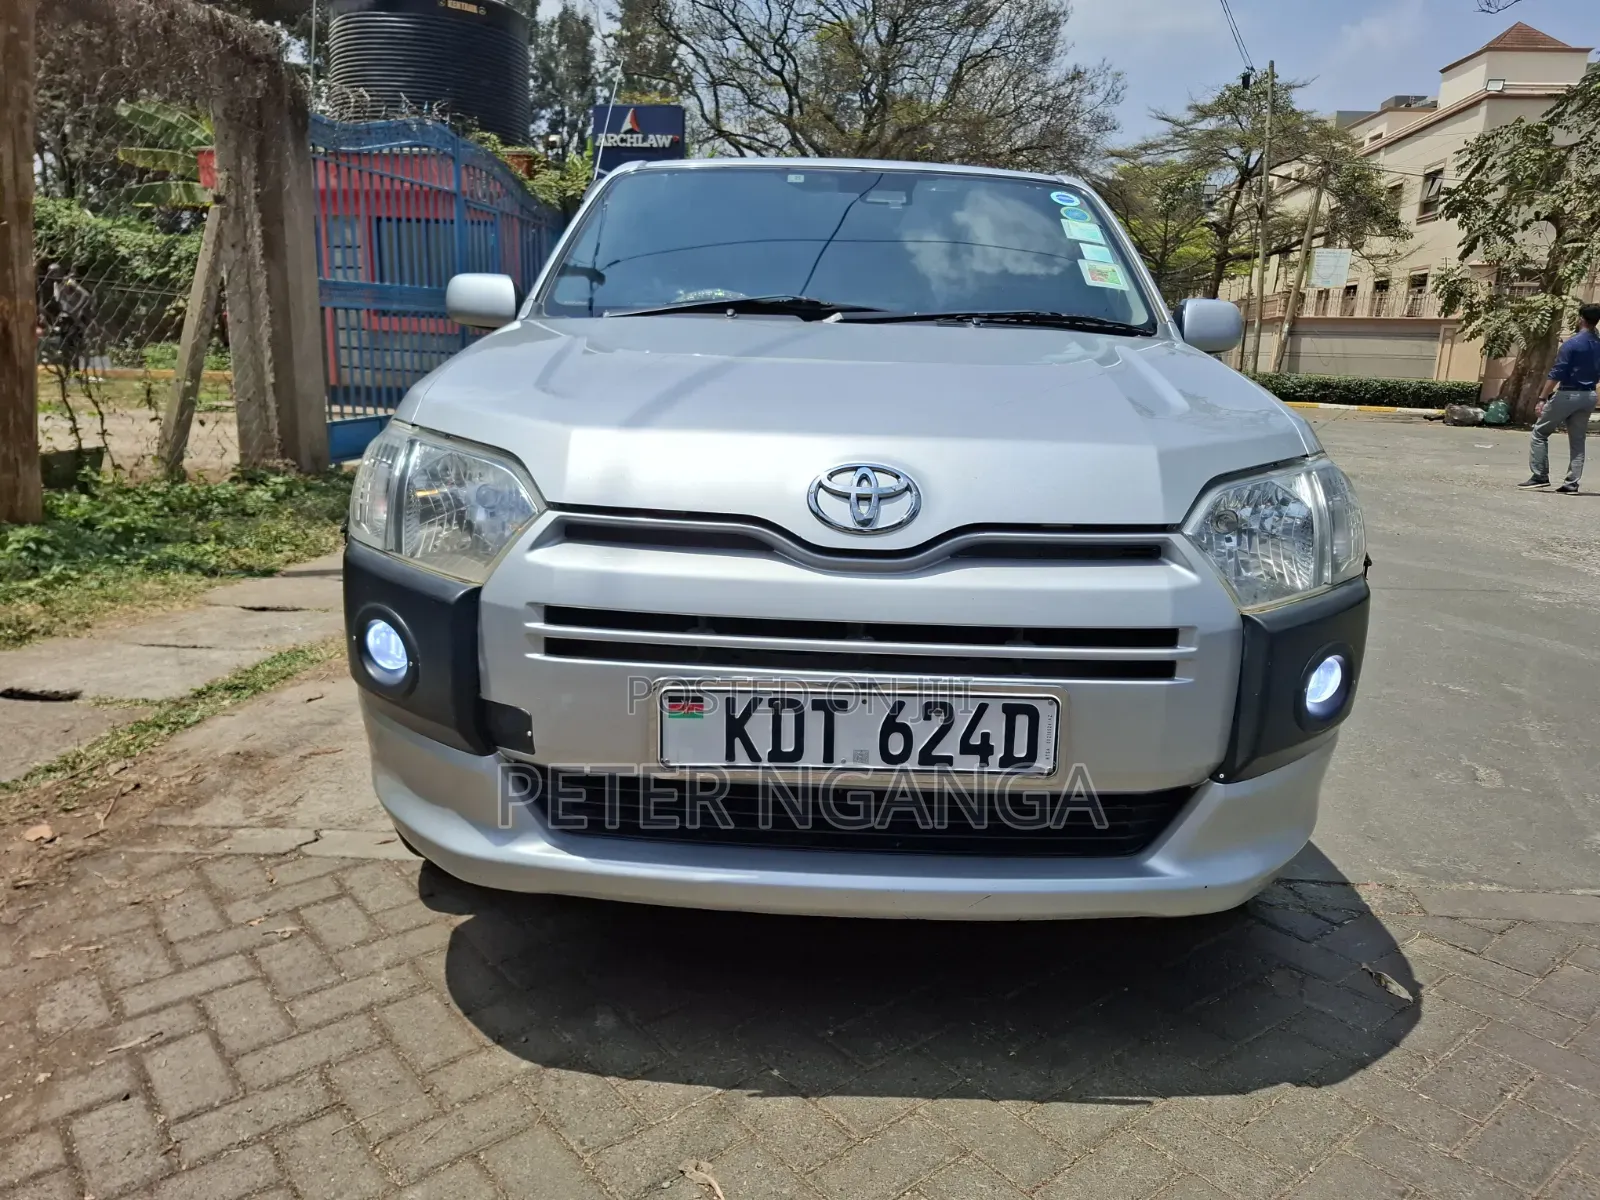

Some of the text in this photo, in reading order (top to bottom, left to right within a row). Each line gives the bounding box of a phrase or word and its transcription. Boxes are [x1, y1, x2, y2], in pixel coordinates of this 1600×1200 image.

[595, 133, 673, 148] ARCHLAW
[725, 696, 849, 764] KDT
[878, 699, 1040, 769] 624D
